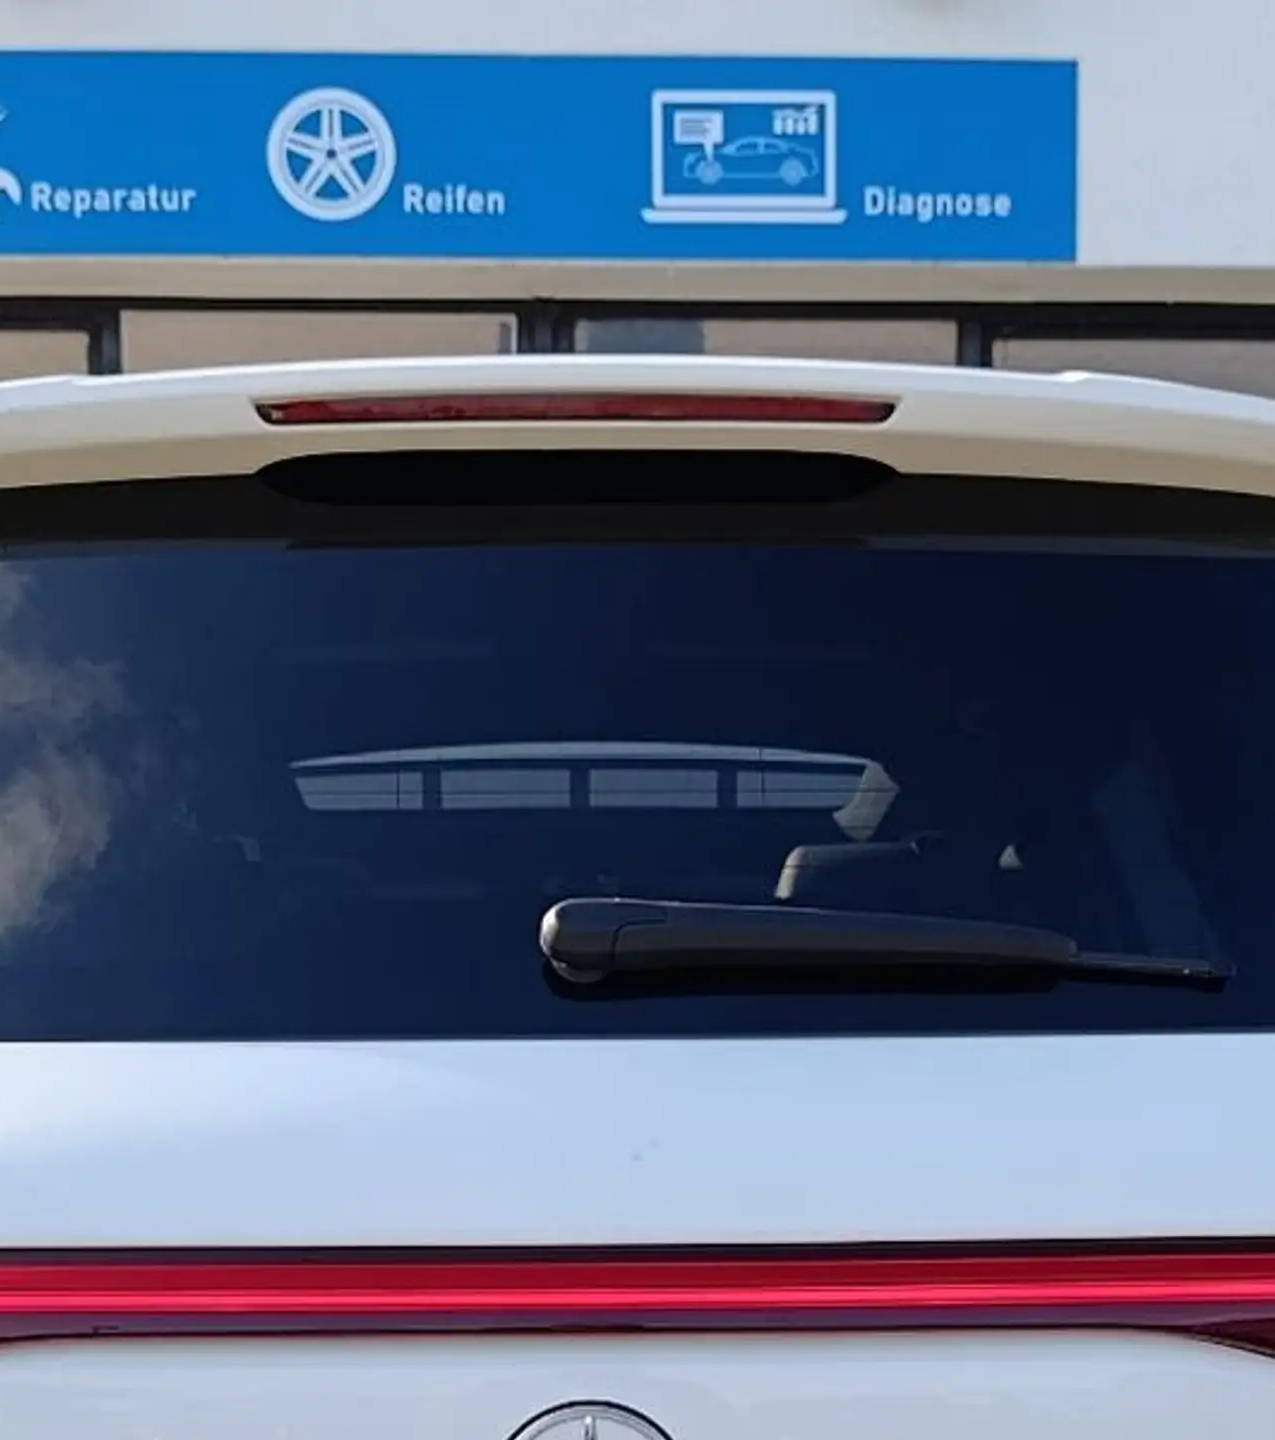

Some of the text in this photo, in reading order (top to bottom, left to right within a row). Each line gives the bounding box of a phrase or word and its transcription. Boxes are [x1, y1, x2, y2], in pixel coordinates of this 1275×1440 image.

[31, 182, 196, 217] Reparatur
[402, 184, 506, 216] Reifen
[864, 187, 1013, 222] Diagnose
